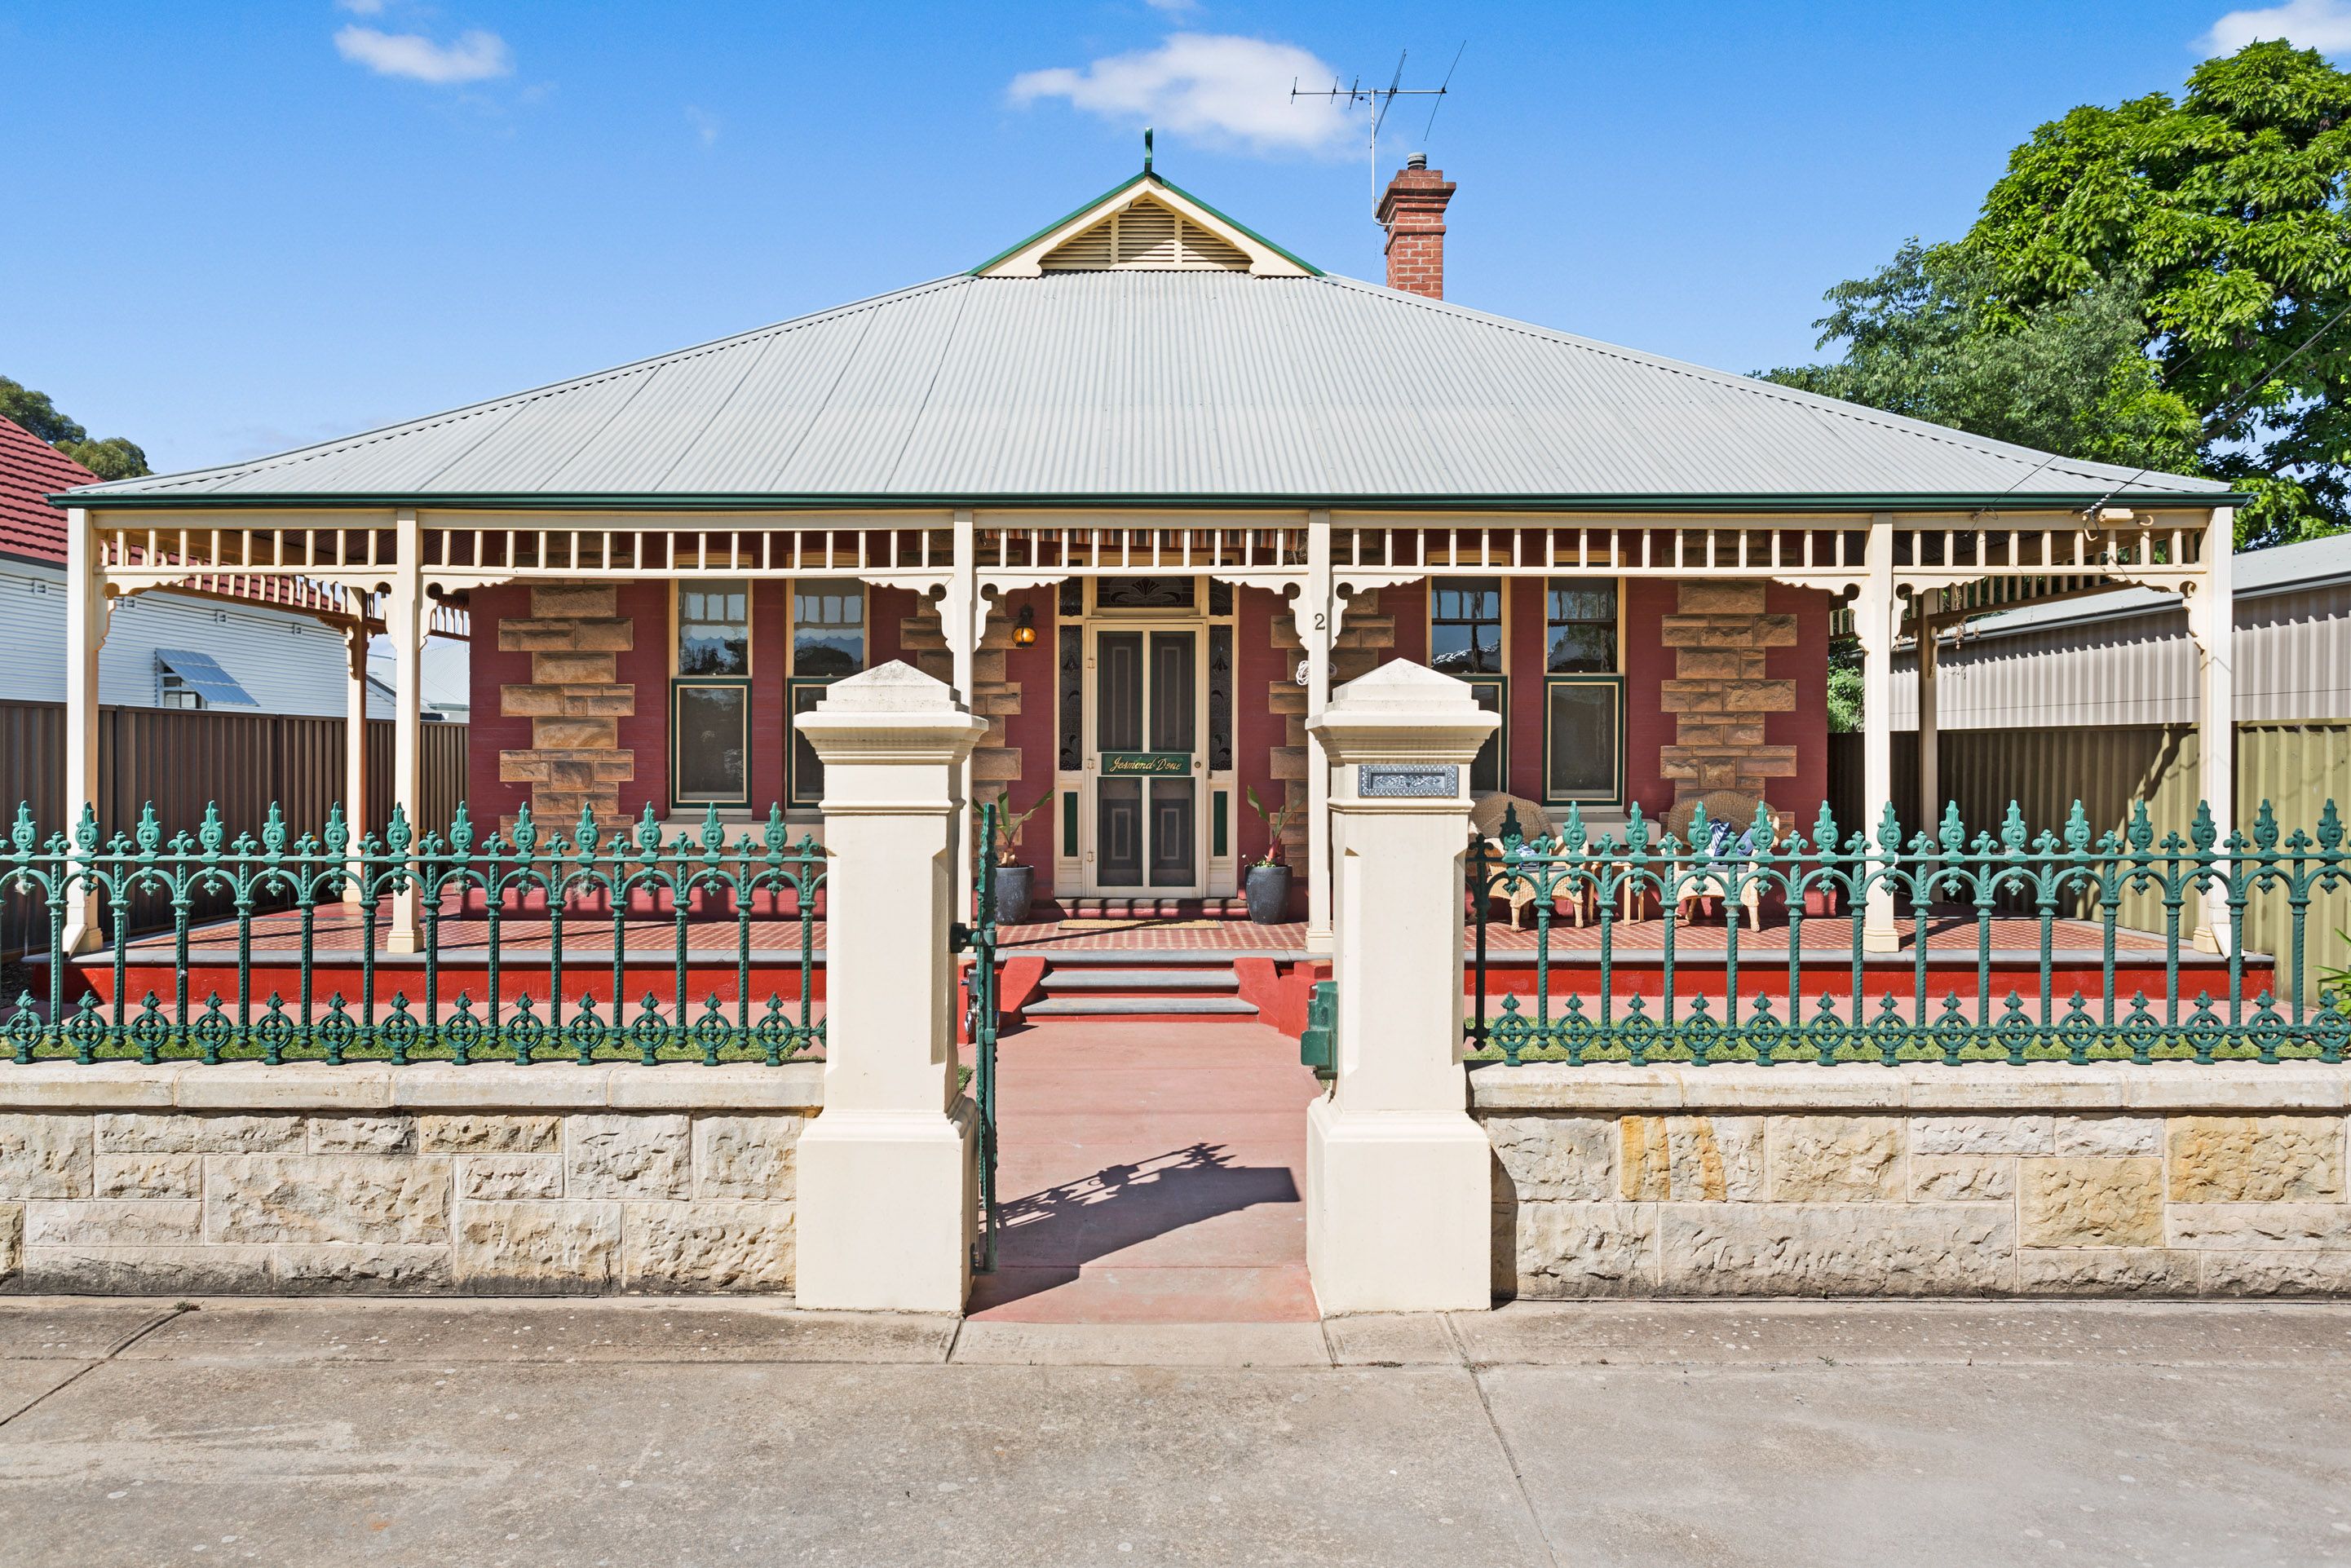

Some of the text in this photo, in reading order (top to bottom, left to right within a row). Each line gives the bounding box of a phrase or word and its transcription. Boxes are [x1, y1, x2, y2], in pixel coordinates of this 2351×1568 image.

[1314, 612, 1326, 630] 2
[1108, 756, 1182, 772] Jesmond Dene
